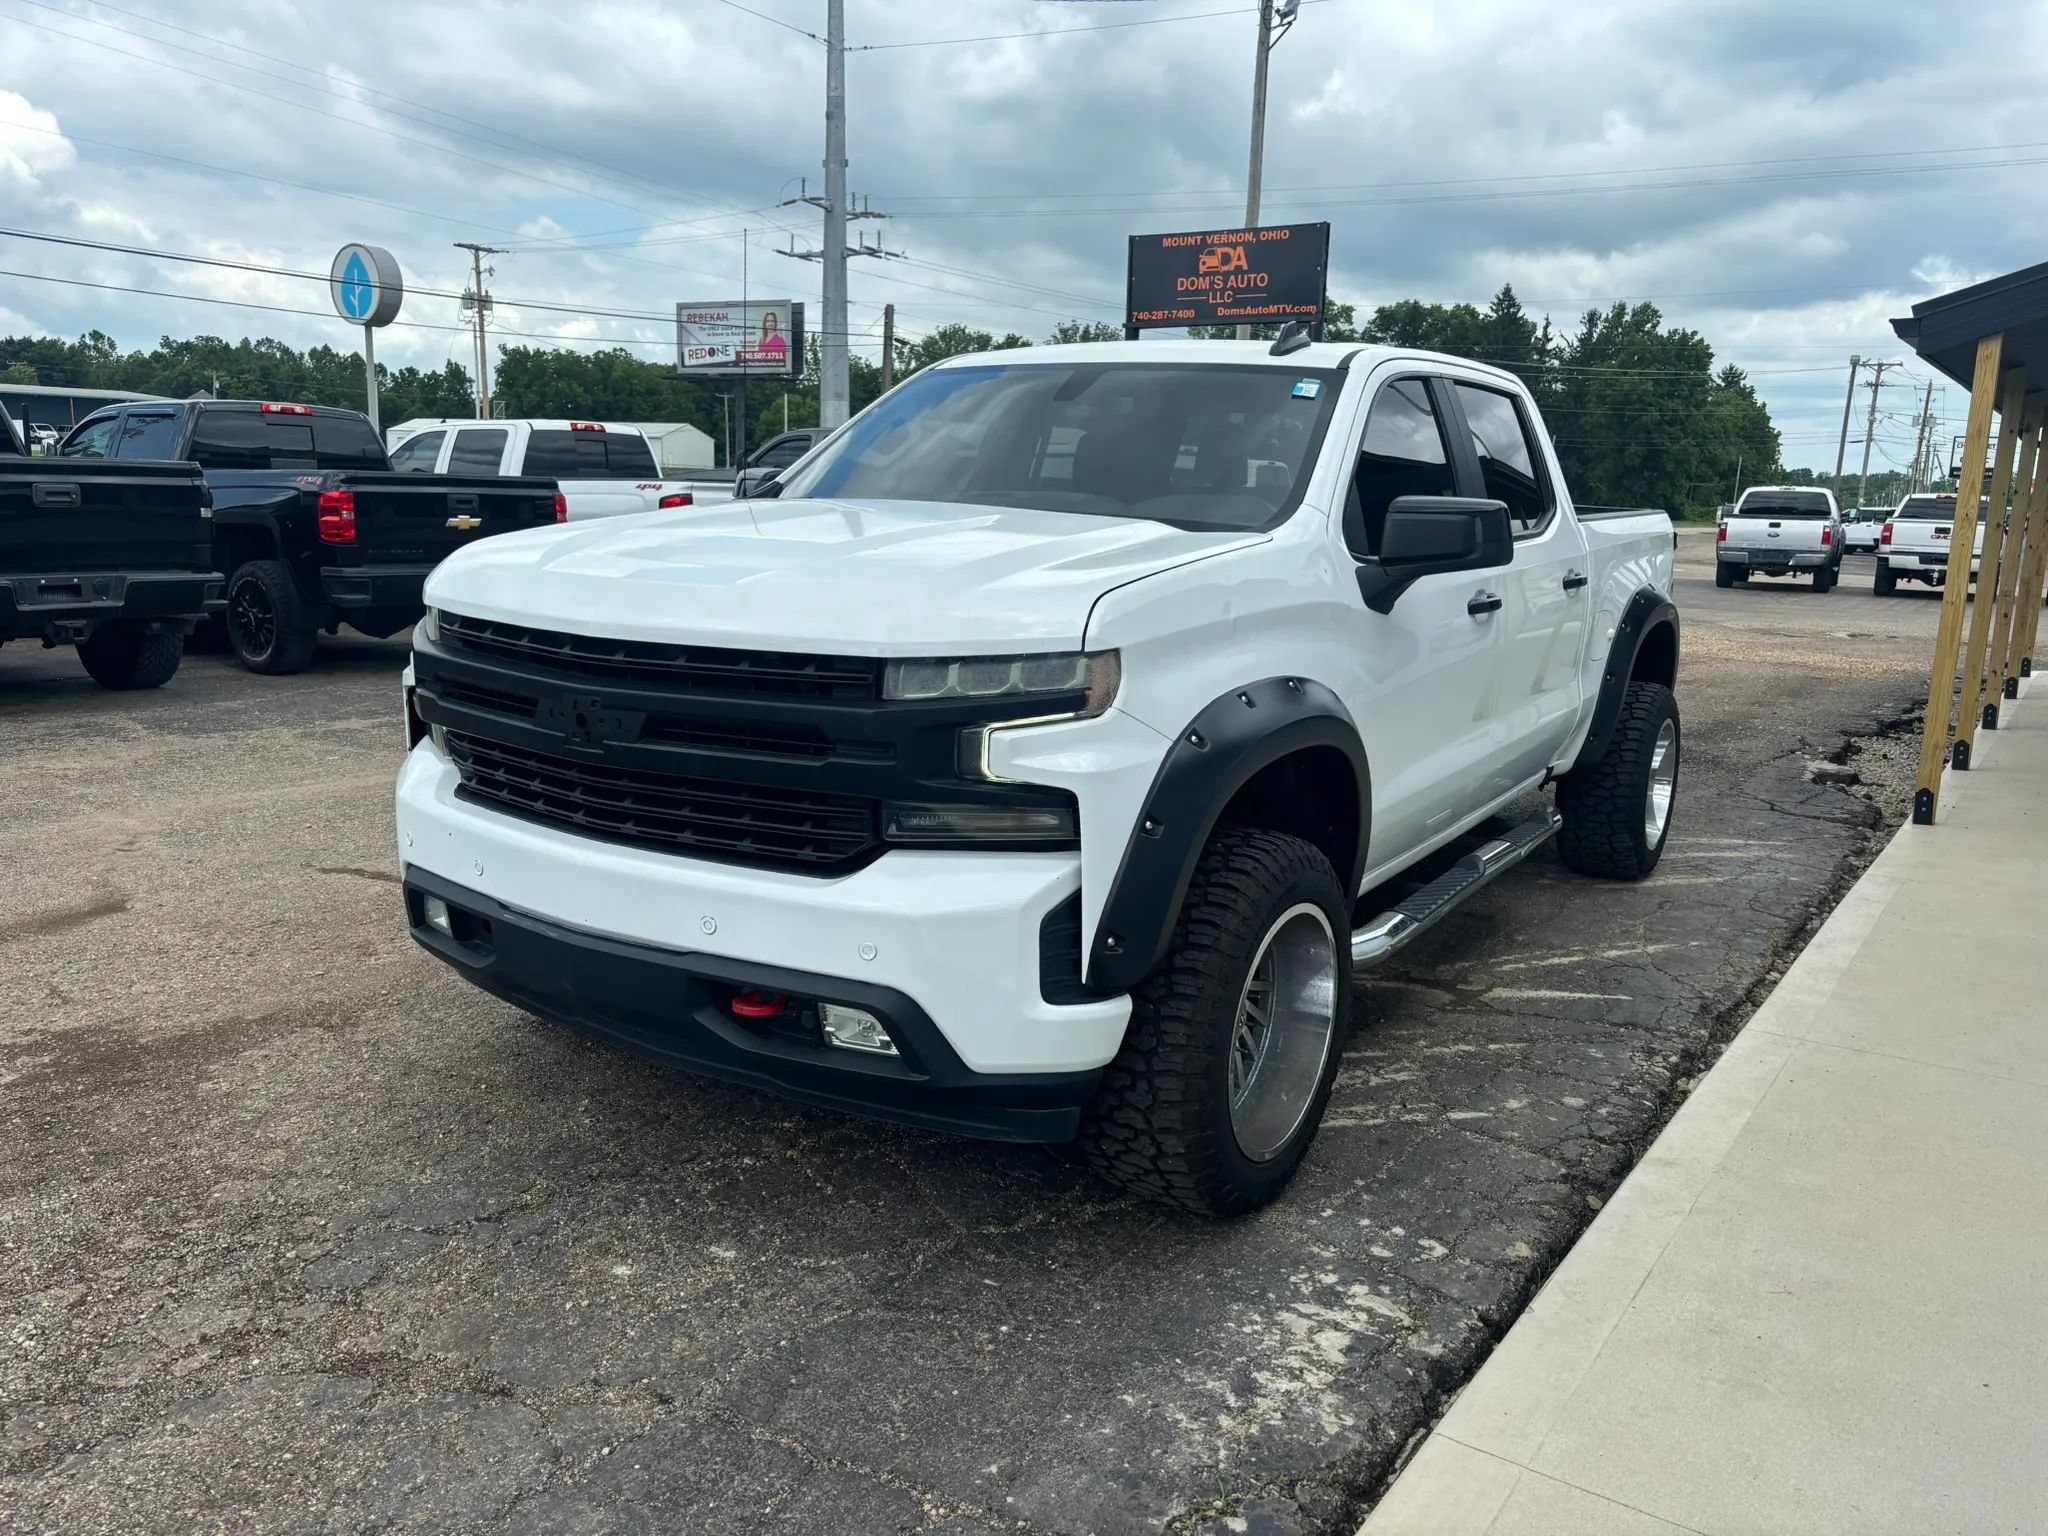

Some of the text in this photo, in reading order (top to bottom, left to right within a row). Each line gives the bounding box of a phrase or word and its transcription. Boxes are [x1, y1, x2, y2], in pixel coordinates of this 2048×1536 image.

[1162, 229, 1290, 247] MOUNT VERNON, OHIO
[1216, 246, 1248, 271] DA
[1177, 273, 1268, 291] DOM'S AUTO
[1209, 291, 1233, 303] LLC
[1132, 309, 1195, 321] 740-287-7400
[1217, 304, 1317, 317] DomsAutoMTV.com
[687, 312, 729, 323] REBEKAH
